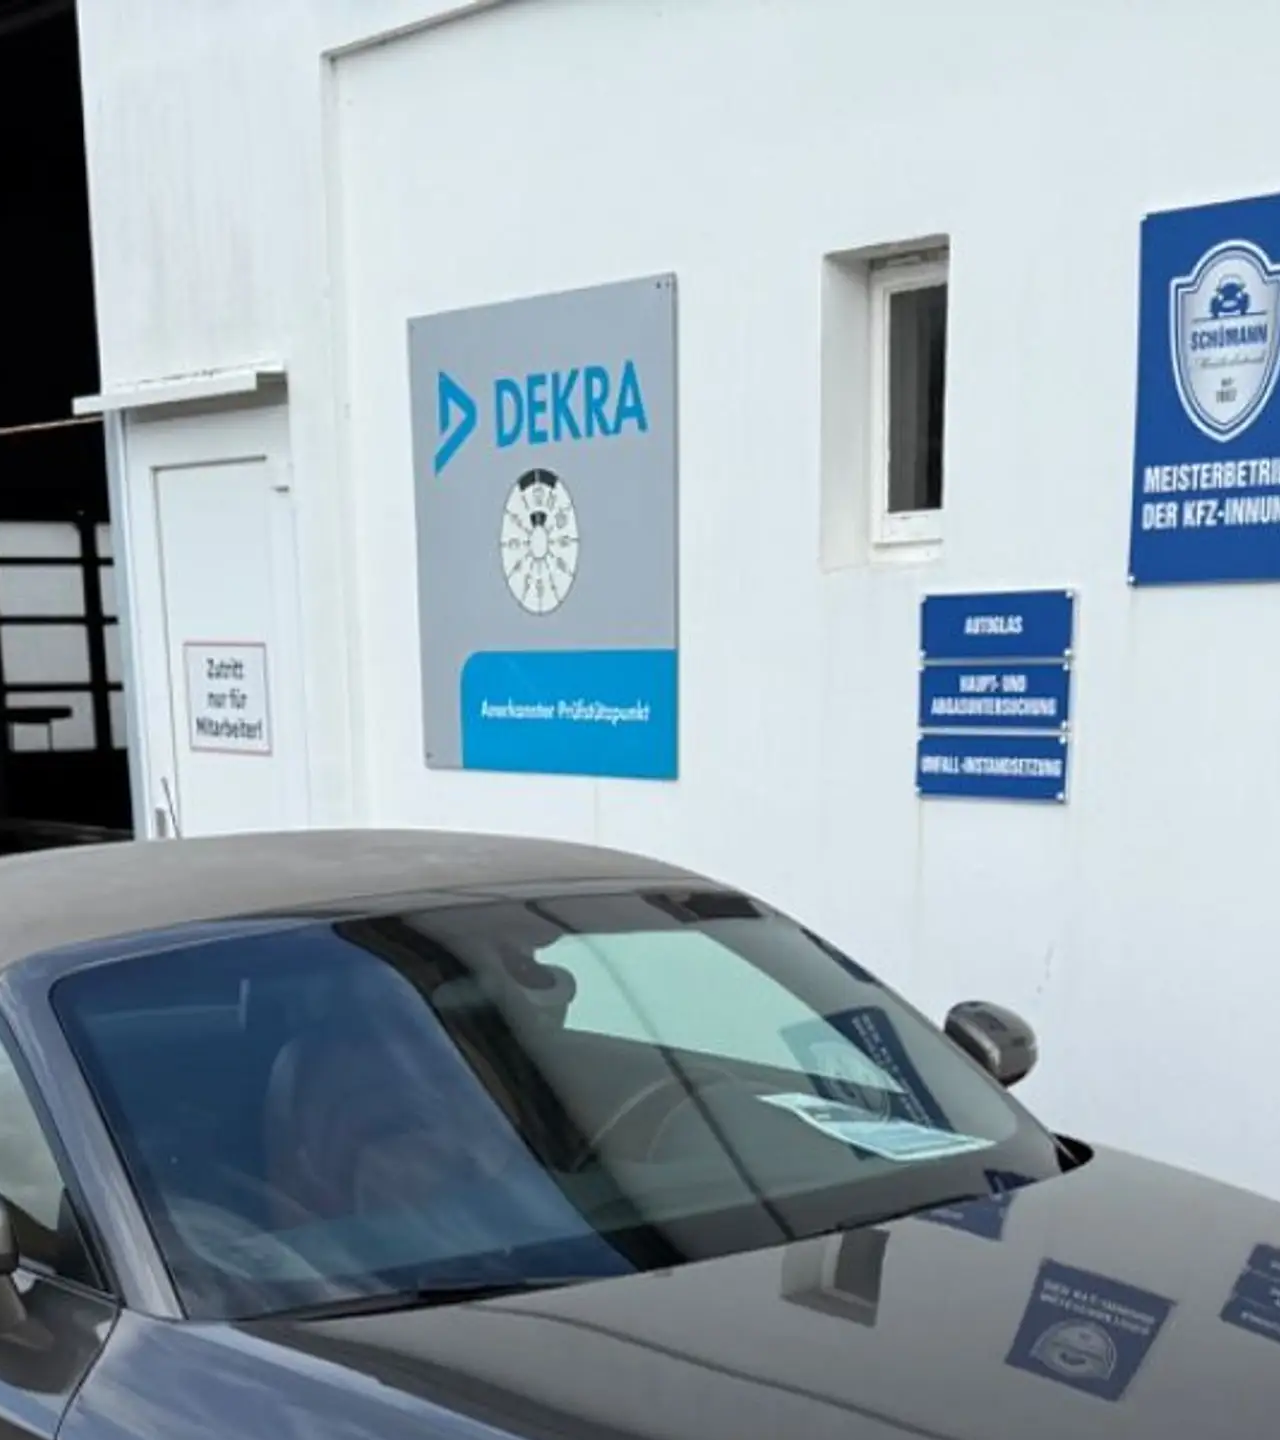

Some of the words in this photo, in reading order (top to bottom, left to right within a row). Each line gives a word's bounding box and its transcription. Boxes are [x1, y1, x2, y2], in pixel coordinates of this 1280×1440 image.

[1190, 322, 1268, 352] SCHÜMANN
[493, 359, 649, 449] DEKRA
[1141, 501, 1178, 531] DER
